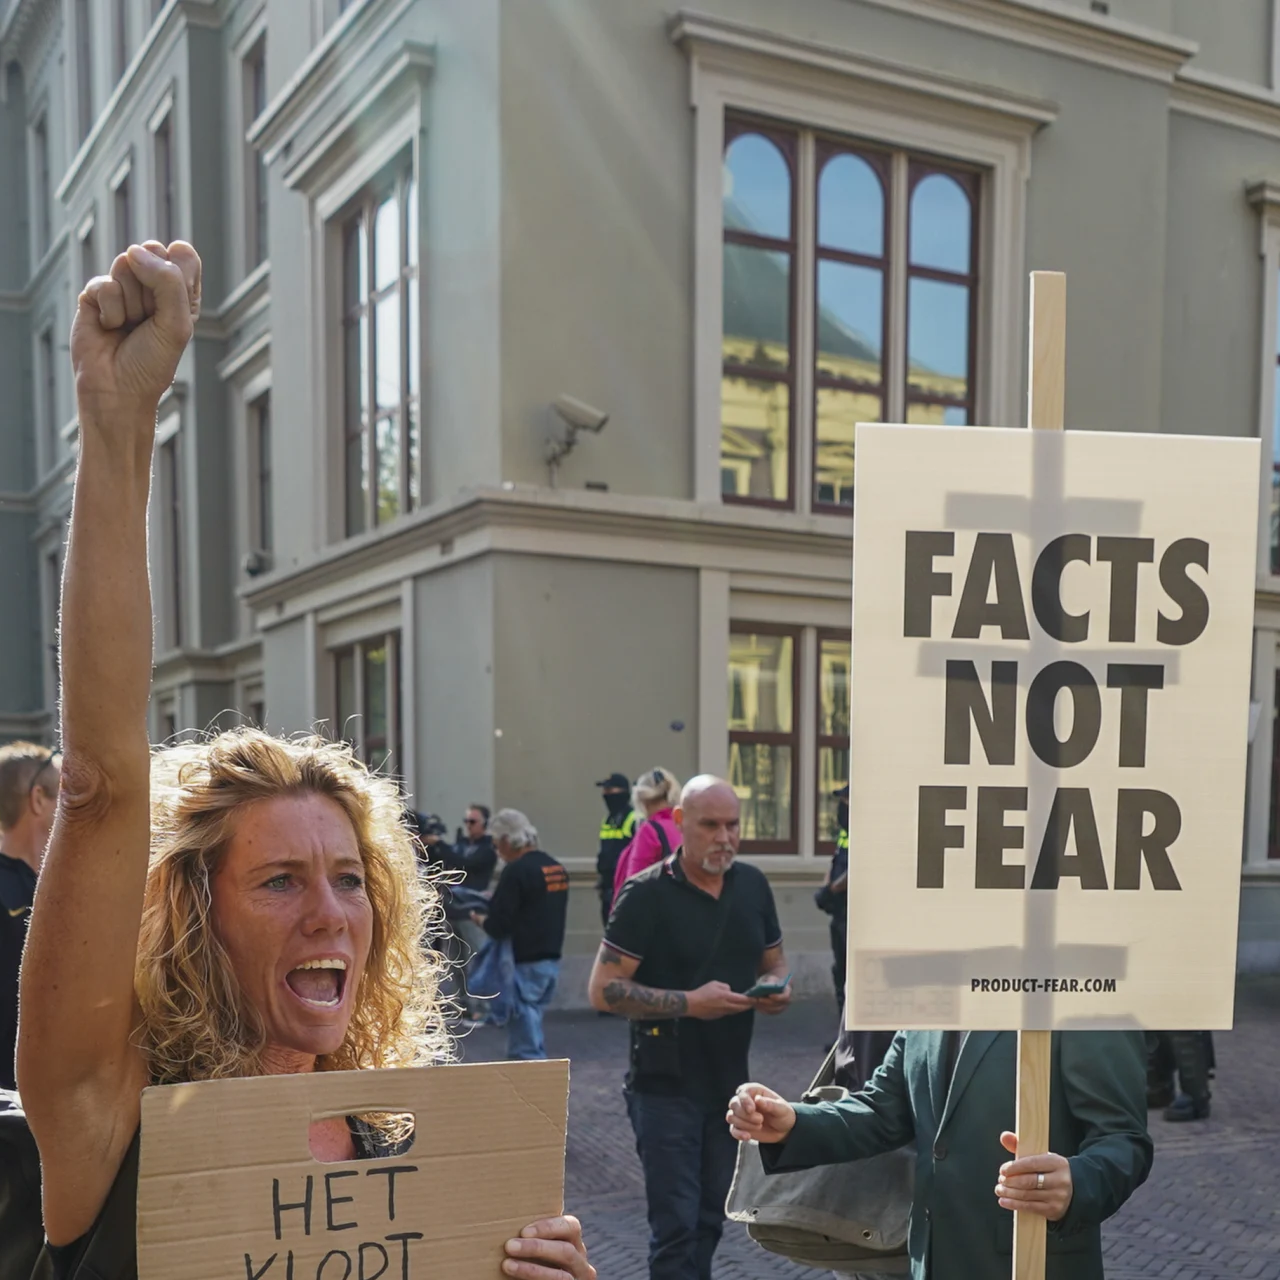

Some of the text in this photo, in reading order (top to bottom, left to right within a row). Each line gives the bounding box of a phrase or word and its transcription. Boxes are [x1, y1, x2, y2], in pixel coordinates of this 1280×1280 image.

[903, 530, 1210, 646] FACTS
[943, 659, 1165, 769] NOT
[916, 785, 1183, 891] FEAR
[970, 978, 1117, 993] PRODUCT-FEAR.COM
[272, 1166, 419, 1240] HET
